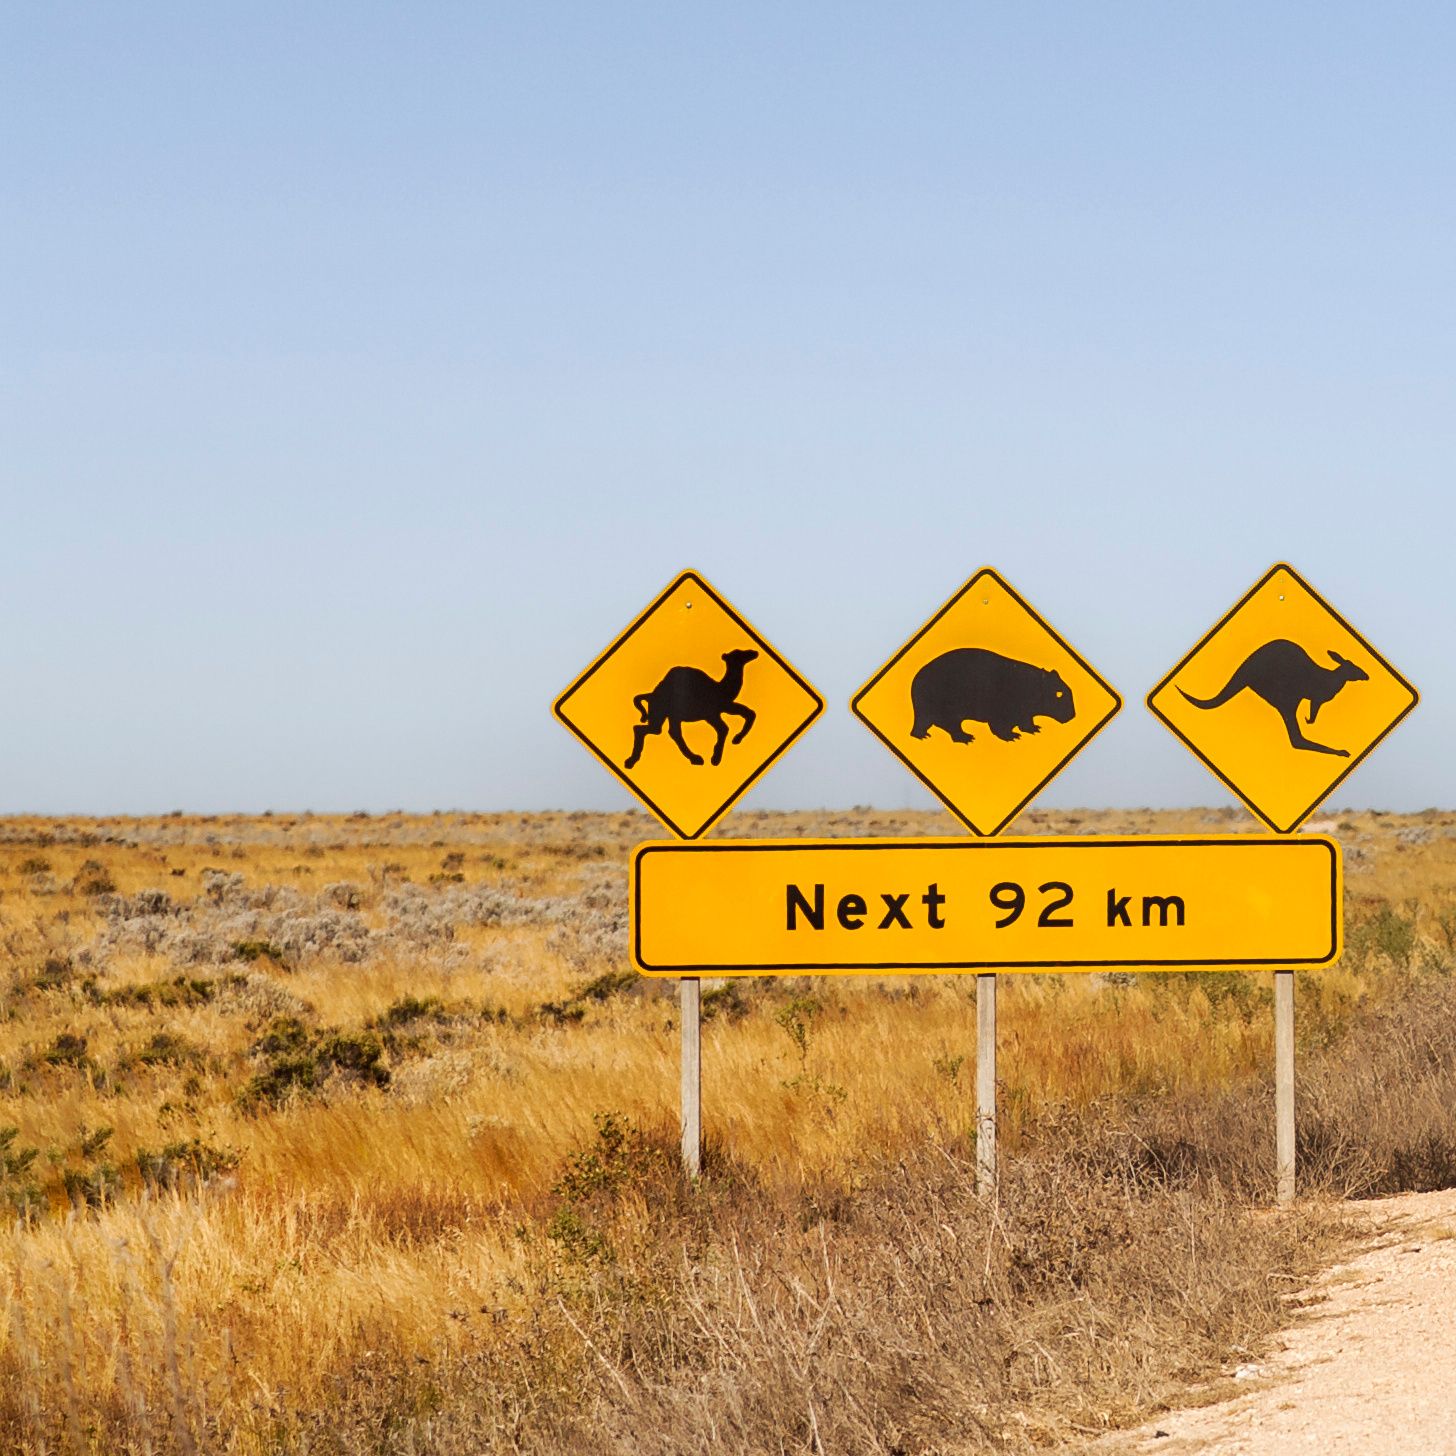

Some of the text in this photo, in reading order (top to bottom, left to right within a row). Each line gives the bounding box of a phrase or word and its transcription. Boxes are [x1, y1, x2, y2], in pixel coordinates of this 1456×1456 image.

[786, 881, 1185, 931] Next 92 km
